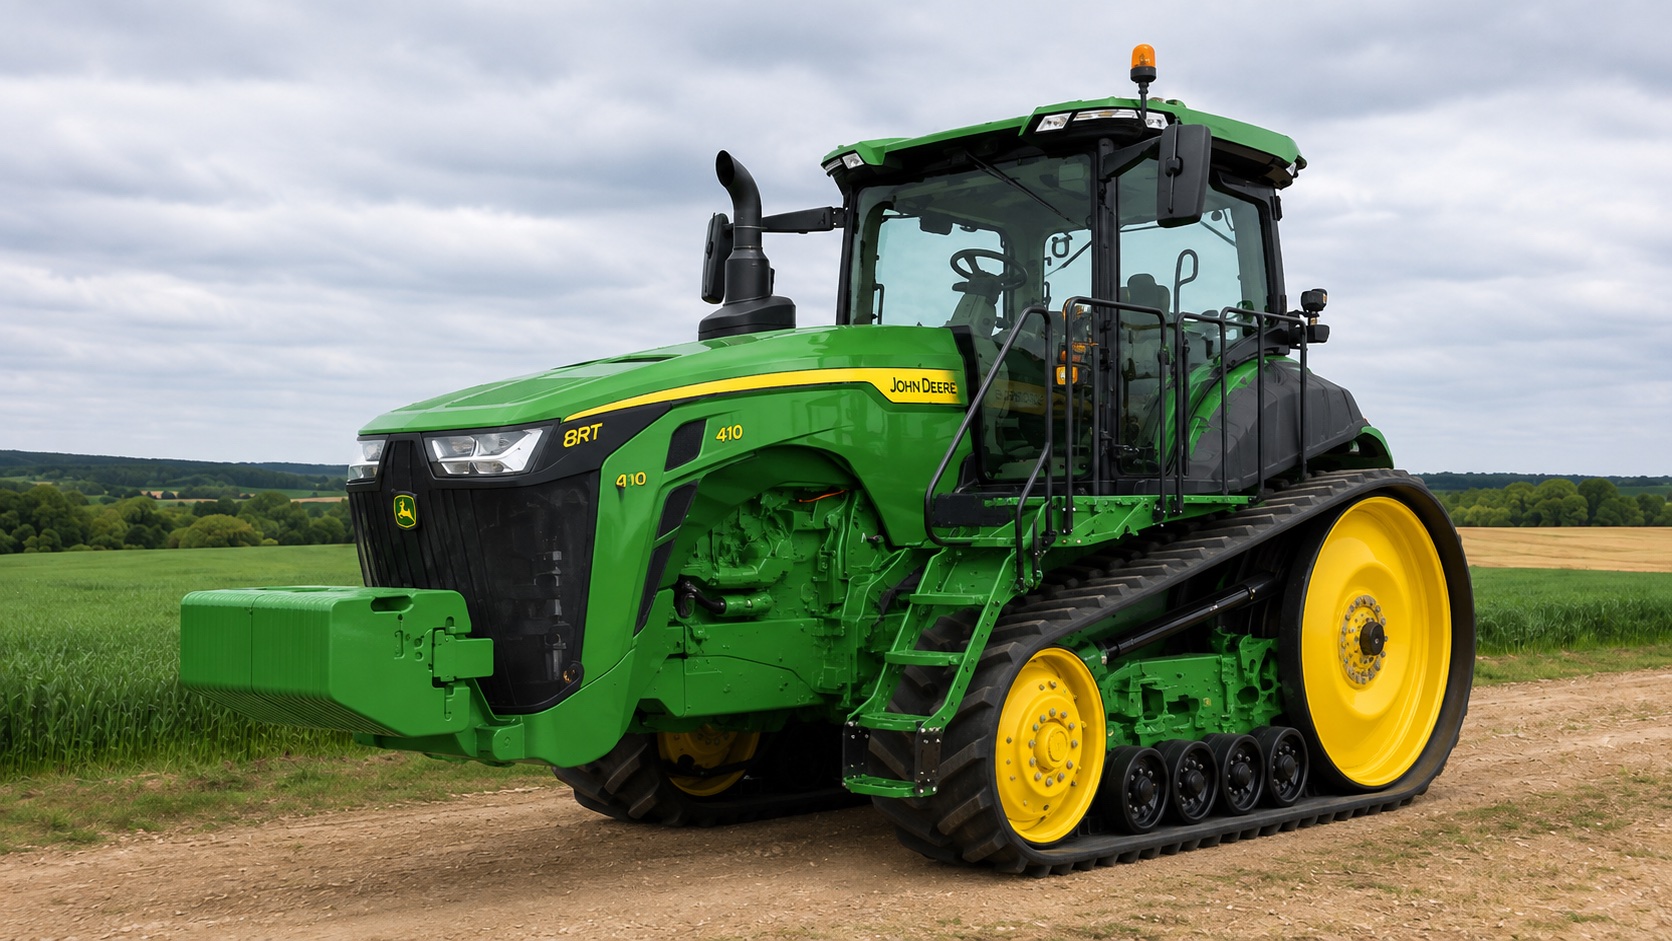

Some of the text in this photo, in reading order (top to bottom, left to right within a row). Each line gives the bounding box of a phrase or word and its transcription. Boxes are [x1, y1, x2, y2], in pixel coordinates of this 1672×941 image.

[890, 376, 958, 395] JOHN DEERE
[563, 422, 603, 448] 8RT
[715, 424, 744, 443] 410
[615, 471, 647, 489] 410
